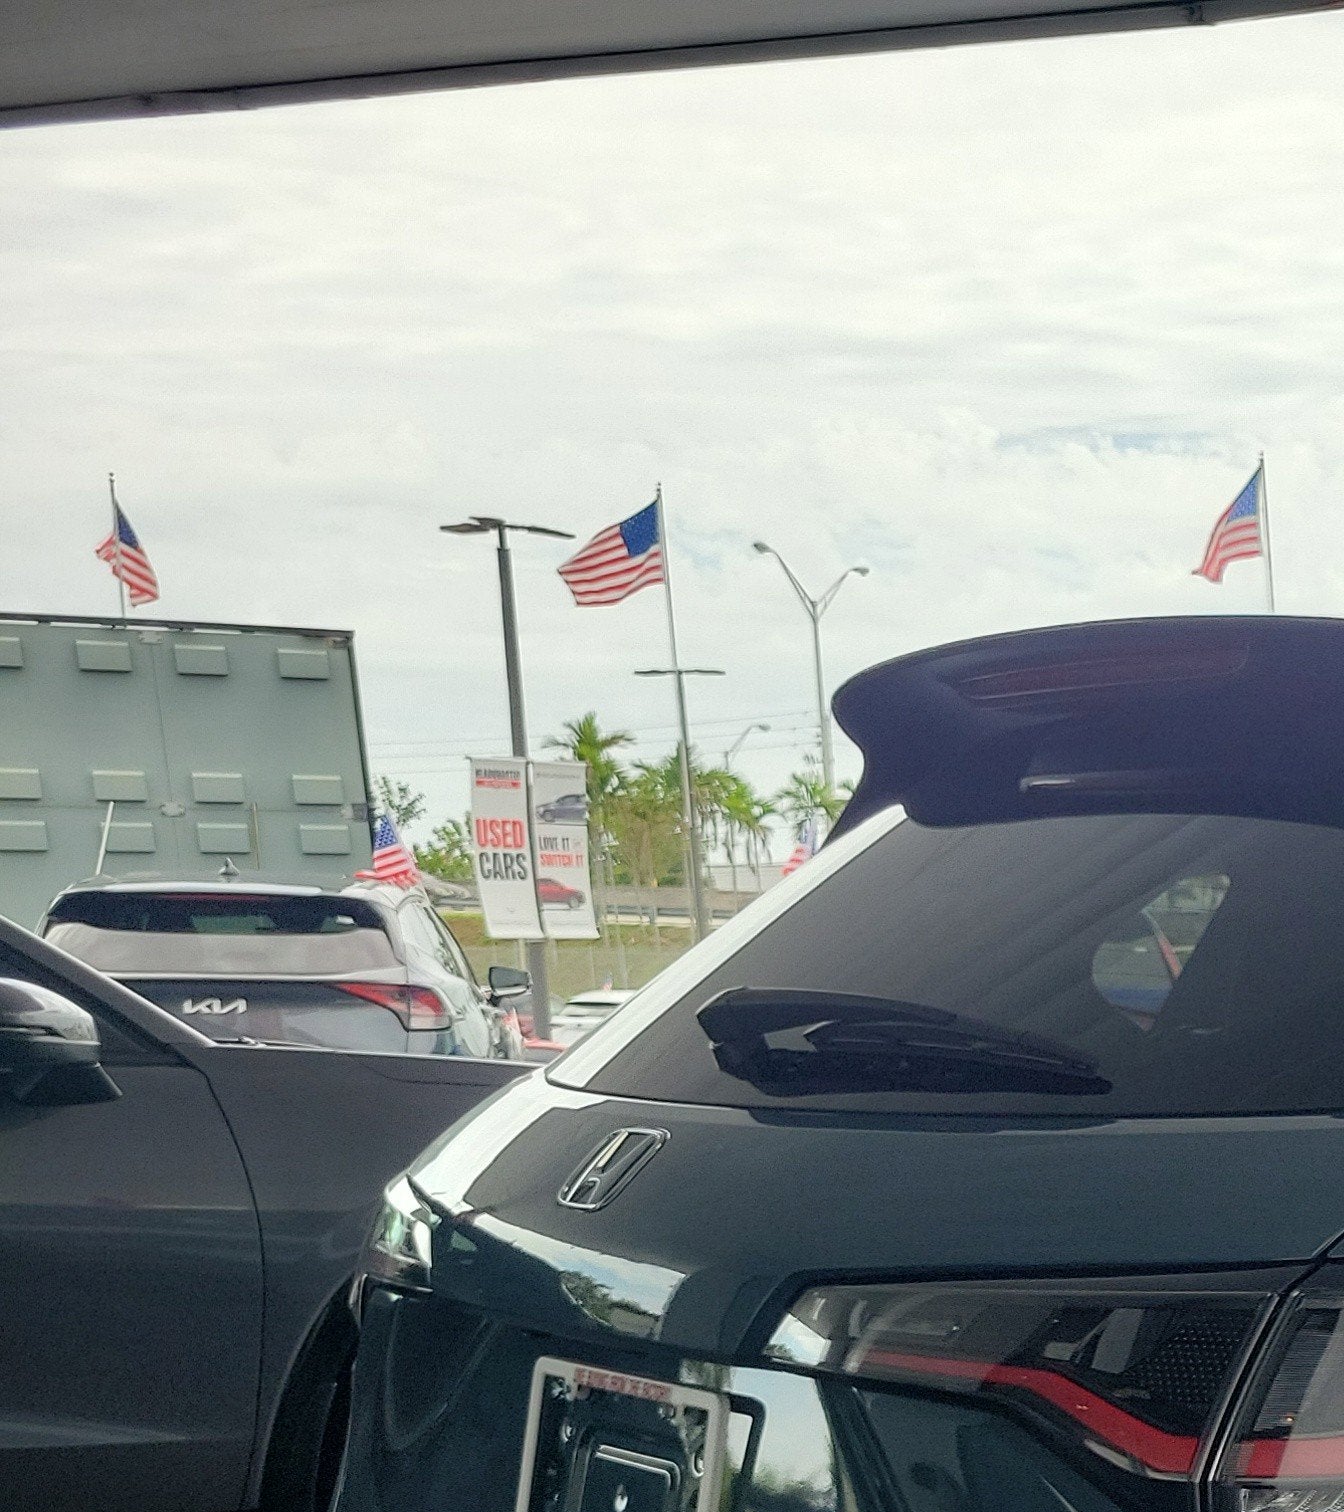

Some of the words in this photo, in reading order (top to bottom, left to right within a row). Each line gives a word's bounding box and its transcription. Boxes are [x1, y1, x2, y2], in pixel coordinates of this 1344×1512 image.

[475, 818, 525, 849] USED
[479, 852, 528, 881] CARS
[183, 998, 247, 1014] KIA
